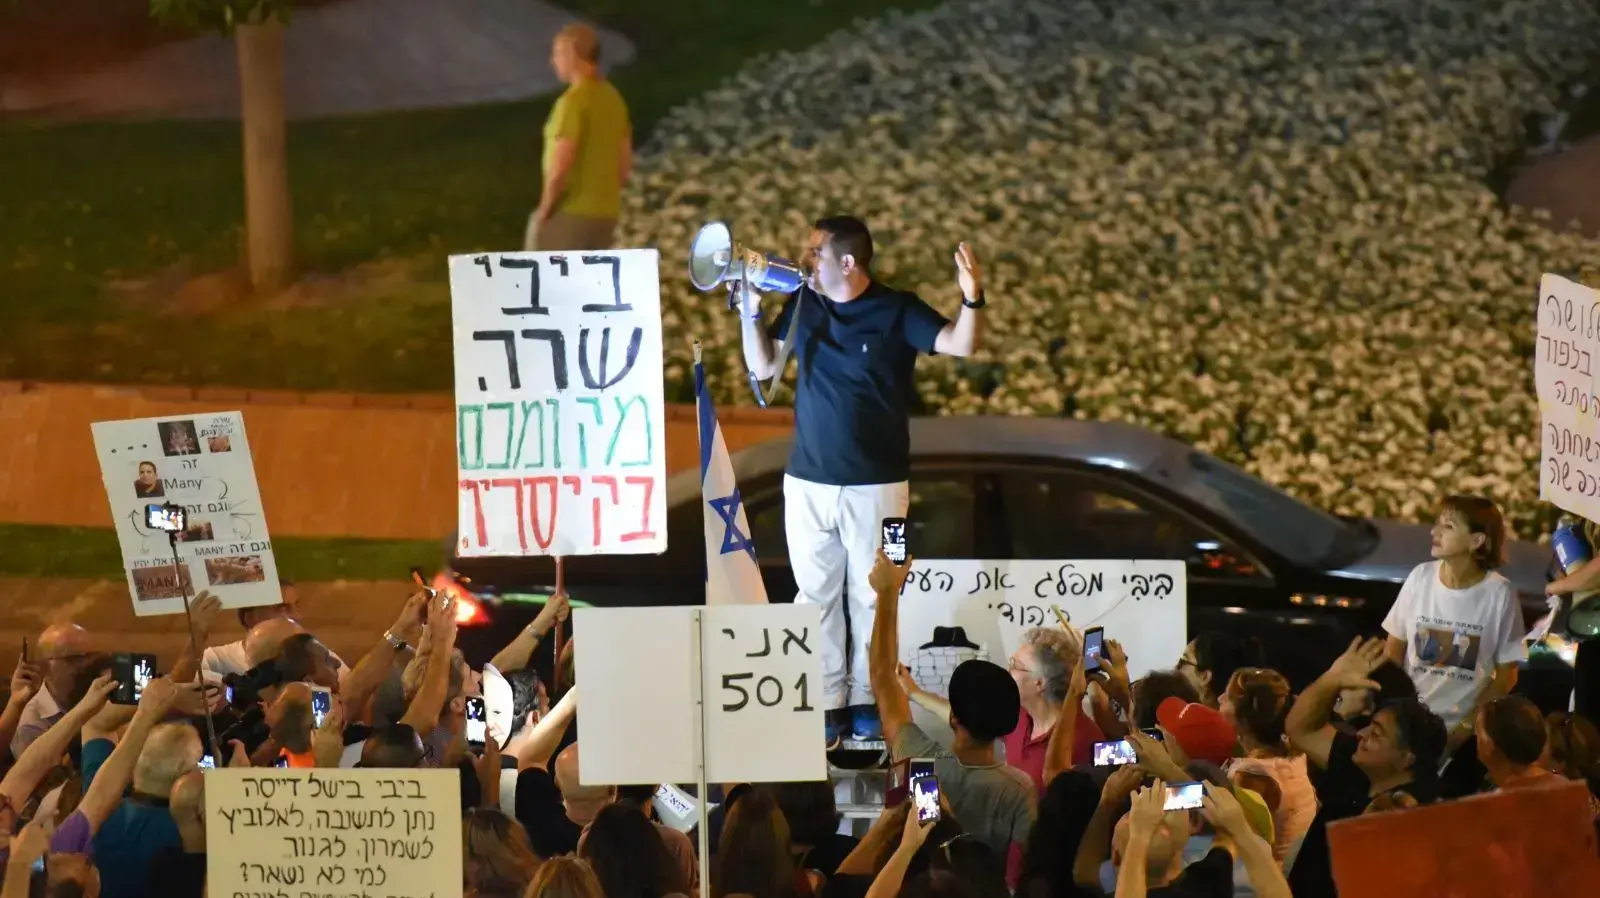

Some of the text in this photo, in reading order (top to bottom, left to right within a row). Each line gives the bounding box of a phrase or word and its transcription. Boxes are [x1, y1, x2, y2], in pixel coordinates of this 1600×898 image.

[1546, 294, 1600, 342] לושה
[472, 326, 643, 392] שרה
[1541, 335, 1592, 377] בלפור
[181, 459, 198, 470] זה
[1548, 457, 1600, 497] כפשה
[164, 478, 202, 490] Many
[187, 502, 228, 514] וגם זה
[194, 541, 271, 556] וגם זה MANY
[968, 567, 1016, 595] את
[1034, 564, 1103, 598] מפלג
[722, 627, 812, 658] אני
[722, 672, 814, 712] 501
[242, 772, 427, 799] ביבי בישל דייסה
[403, 809, 435, 836] נתן
[239, 862, 386, 886] למי לא נשאר?
